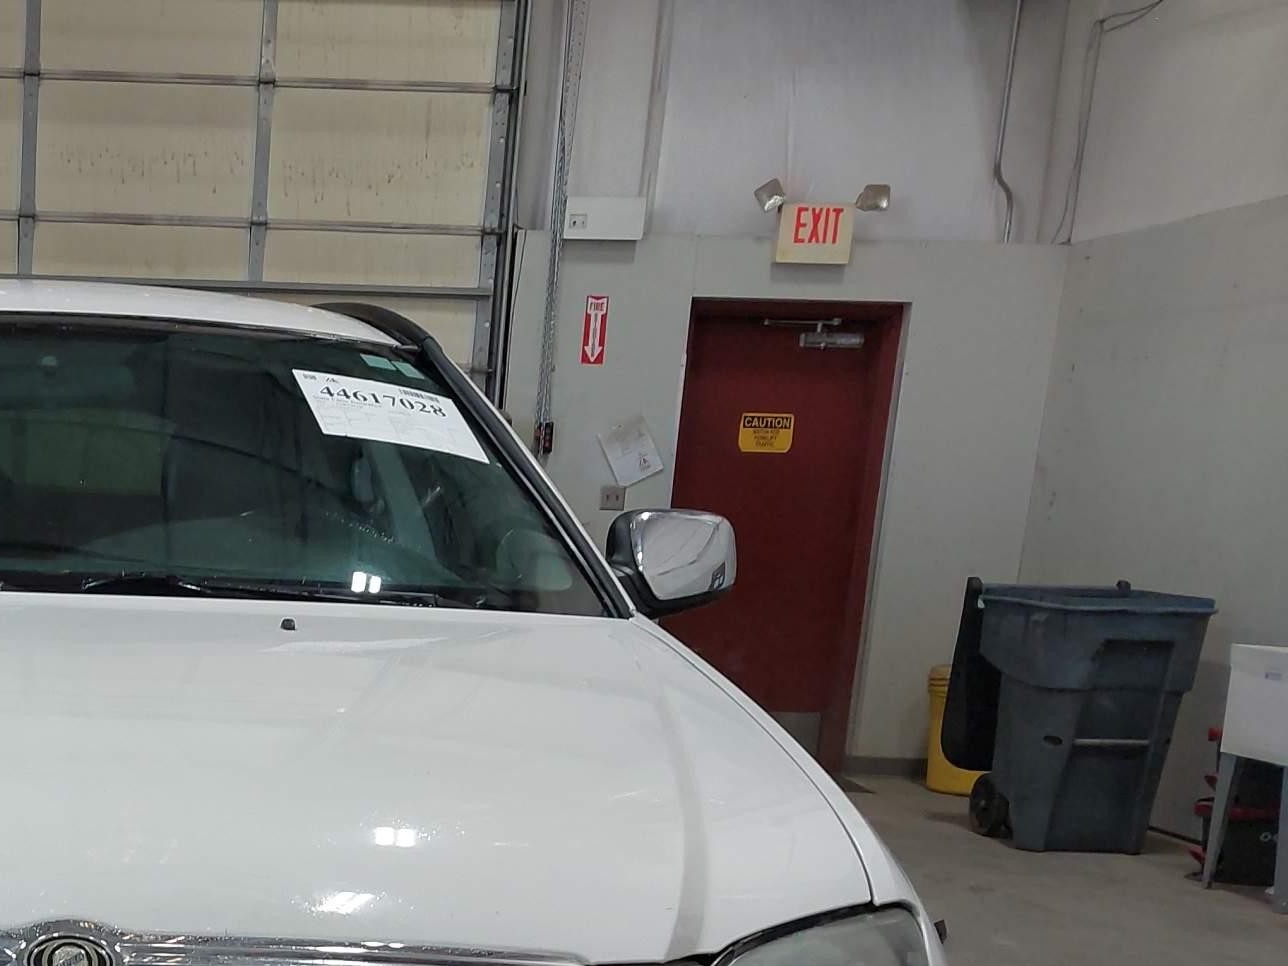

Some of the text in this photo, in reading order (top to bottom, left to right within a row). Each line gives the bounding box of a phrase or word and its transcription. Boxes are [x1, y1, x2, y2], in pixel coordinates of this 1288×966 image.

[793, 206, 844, 245] EXIT
[320, 386, 446, 417] 44617028
[744, 416, 791, 428] CAUTION
